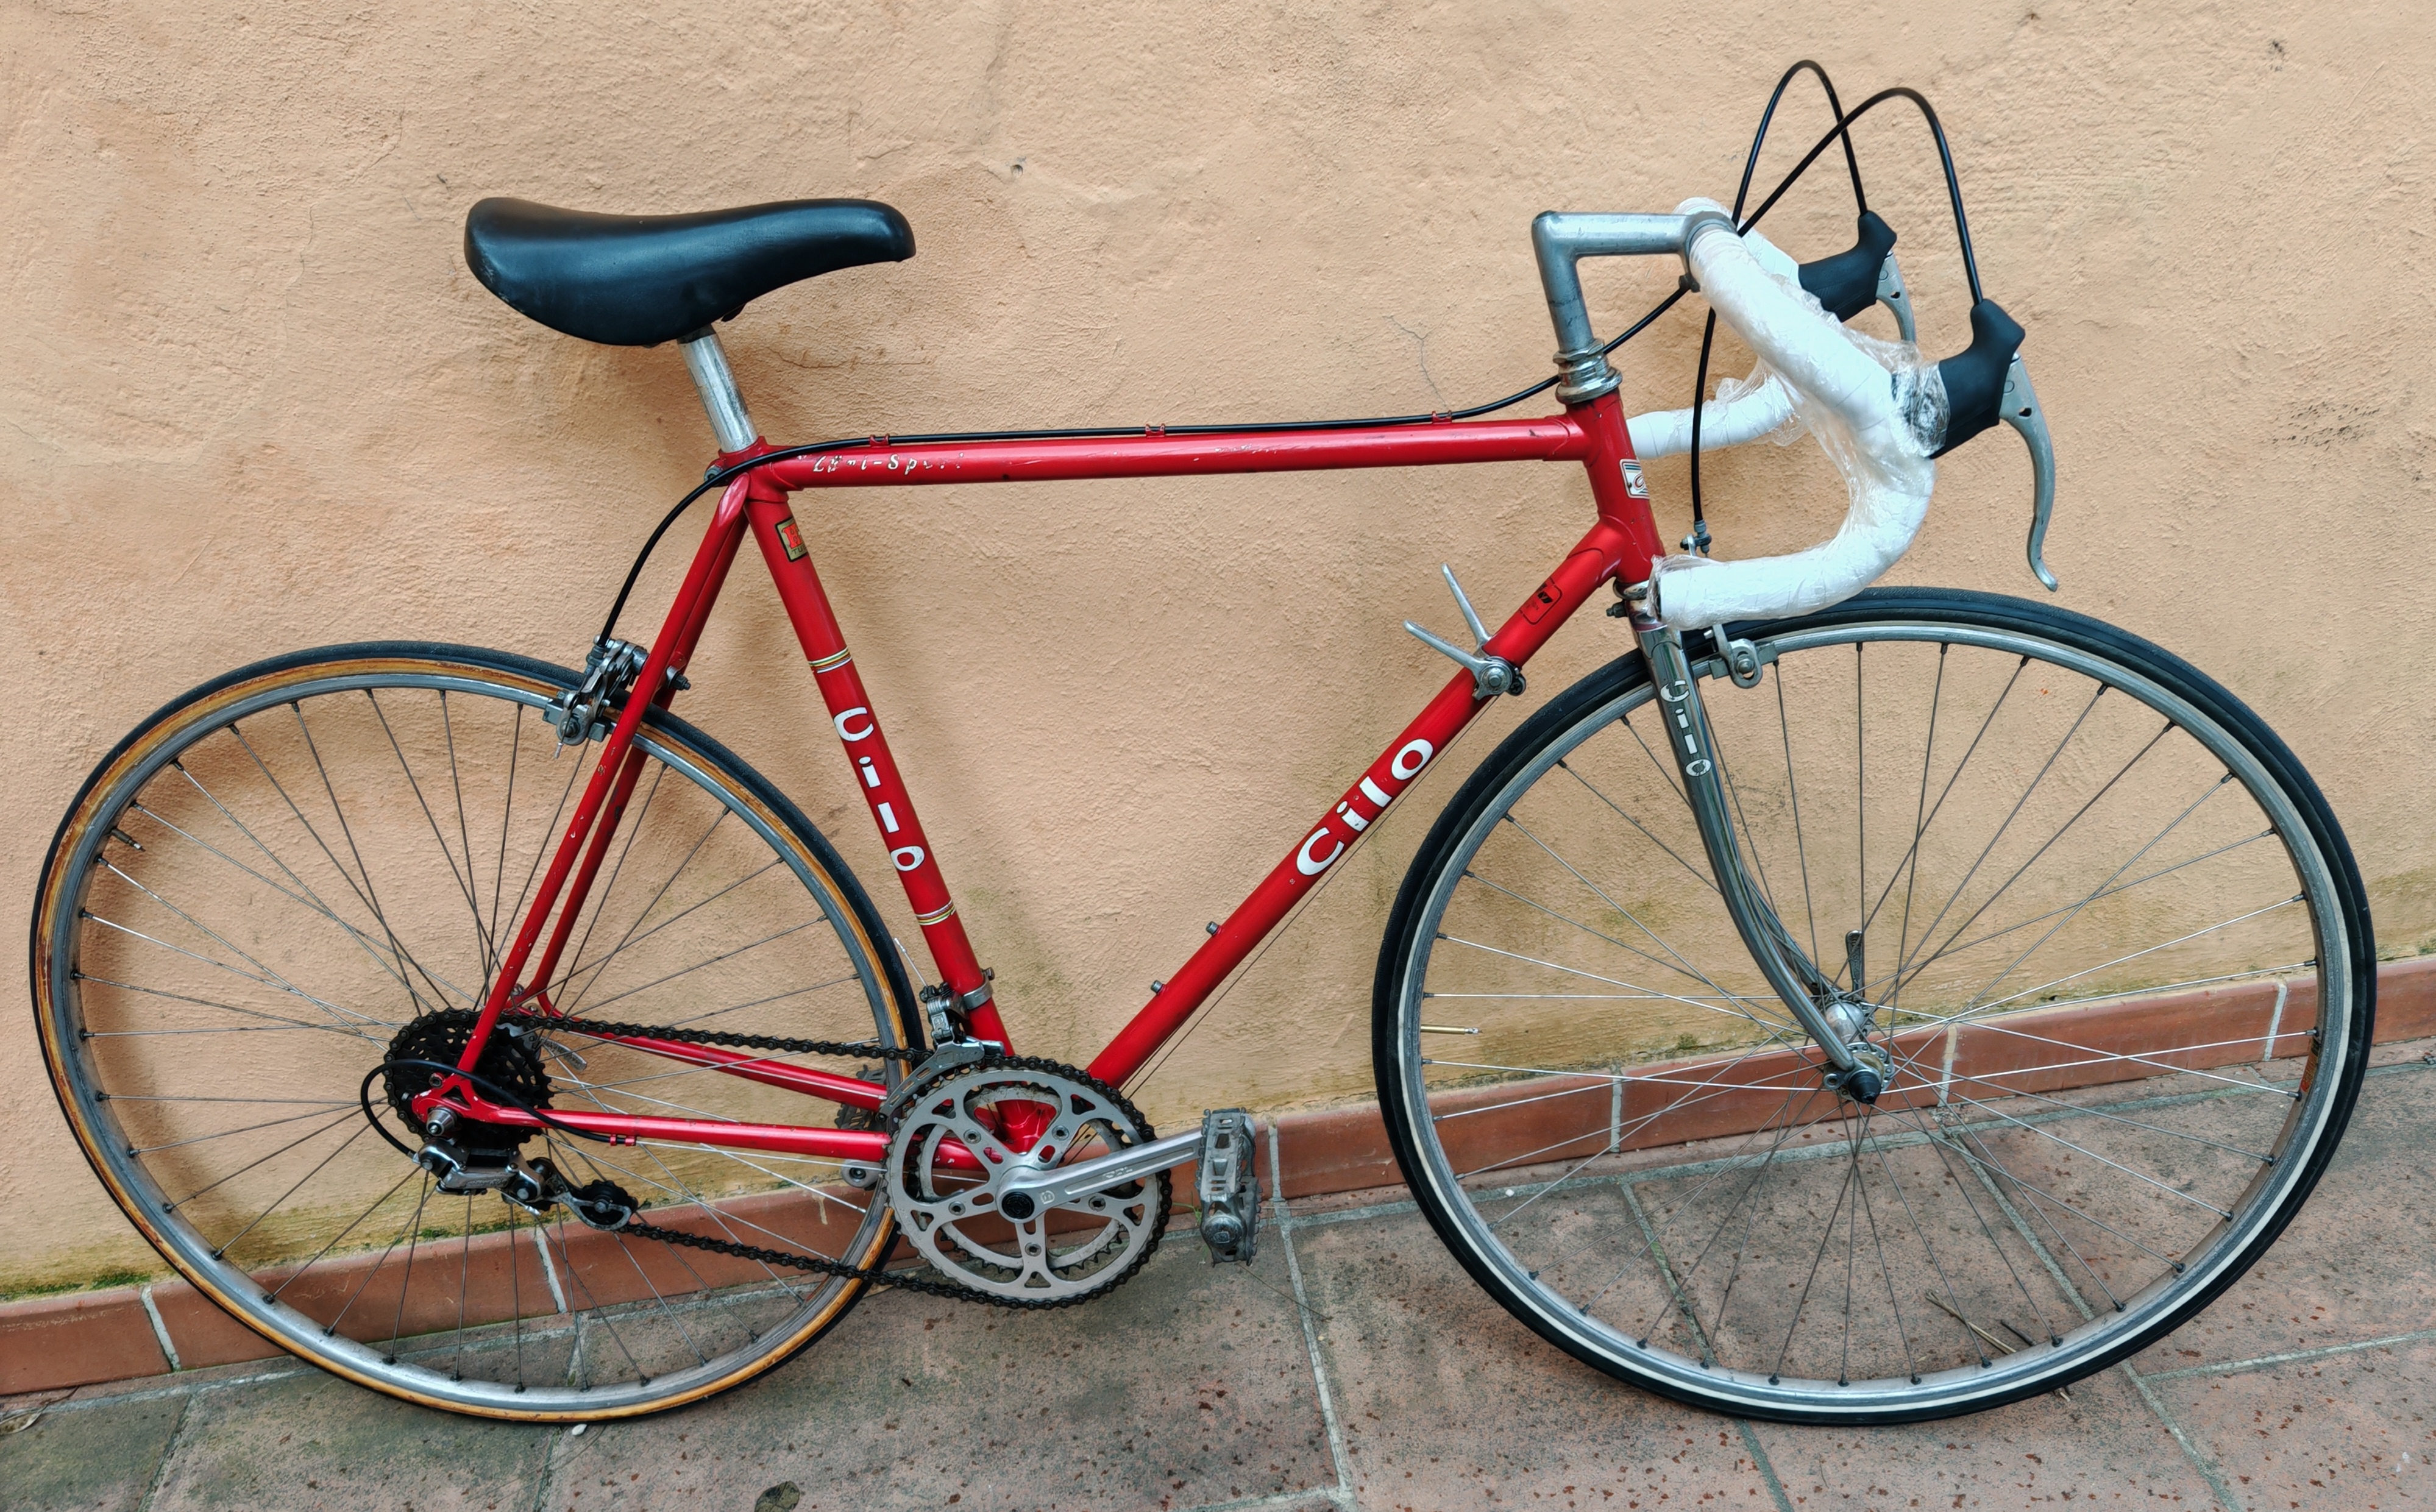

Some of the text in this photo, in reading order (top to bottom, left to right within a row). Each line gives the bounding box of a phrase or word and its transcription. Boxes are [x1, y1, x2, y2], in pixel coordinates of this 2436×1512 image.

[833, 707, 925, 871] Cilo
[1660, 680, 1711, 776] Cilo
[1296, 738, 1433, 876] Cilo
